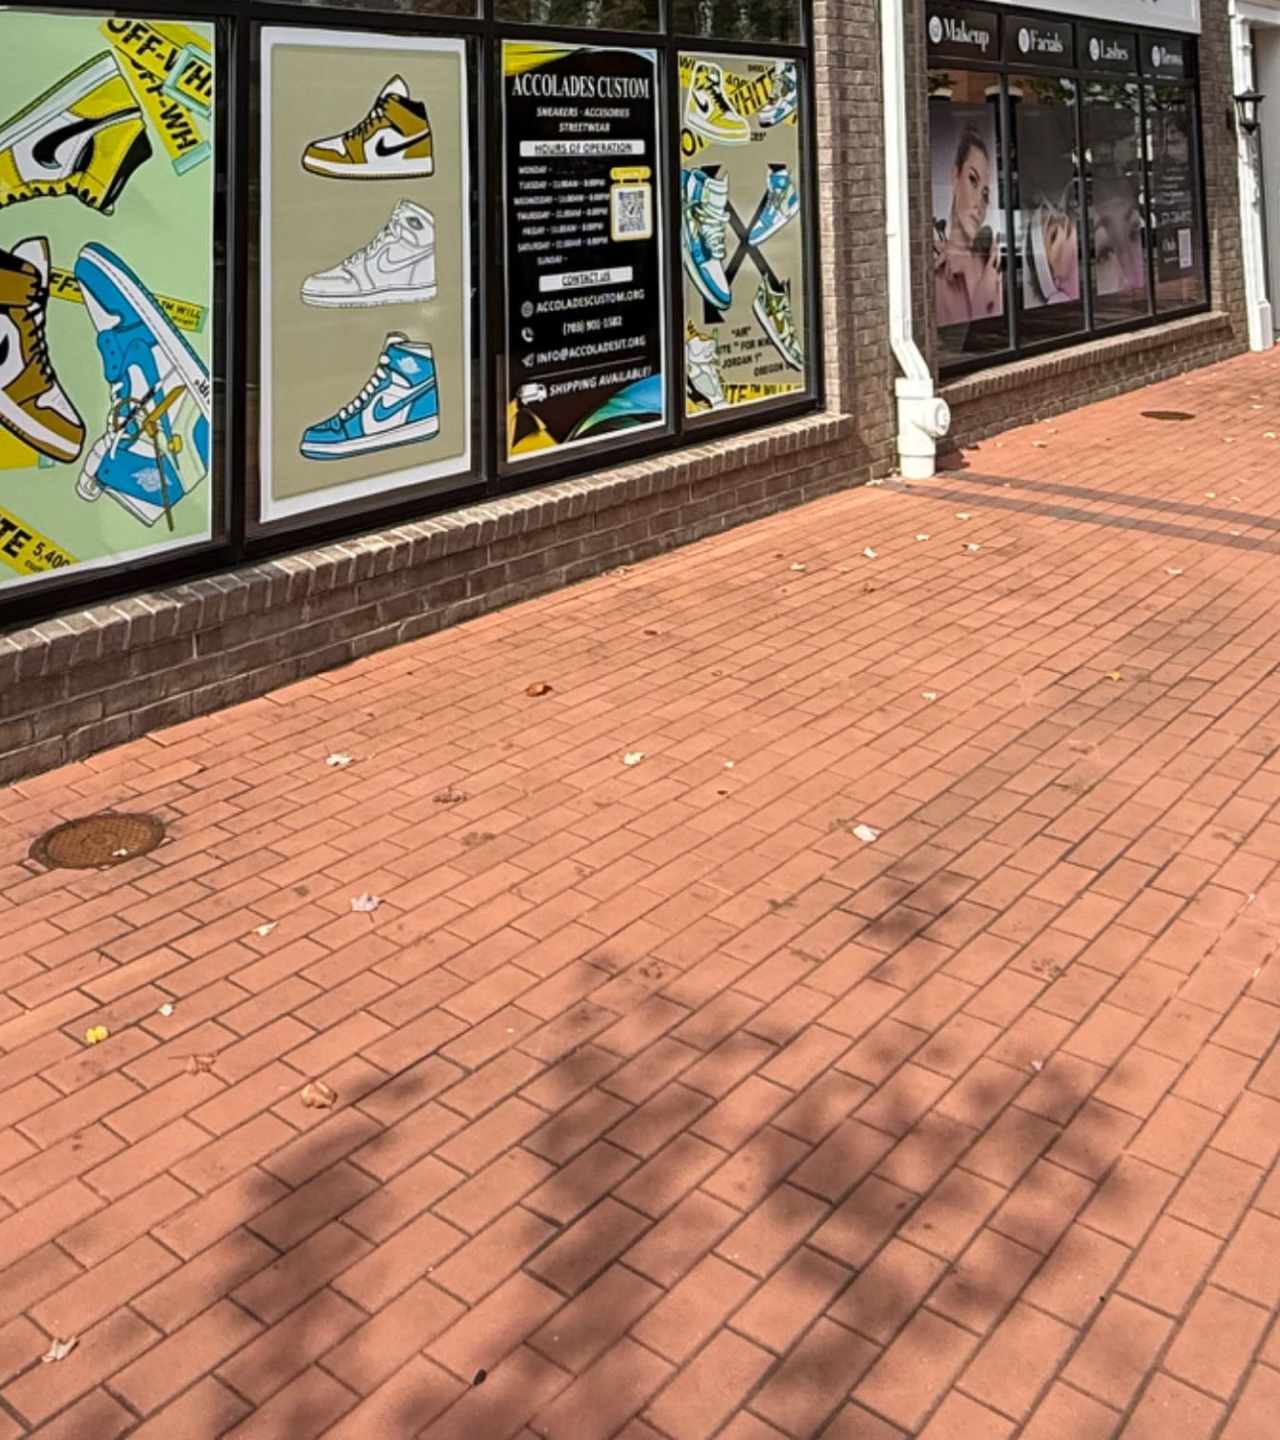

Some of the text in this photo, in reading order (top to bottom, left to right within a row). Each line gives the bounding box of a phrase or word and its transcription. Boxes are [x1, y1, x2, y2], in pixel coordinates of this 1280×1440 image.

[943, 17, 990, 53] Makeup
[1029, 25, 1064, 54] Facials
[1099, 40, 1129, 61] Lashes
[511, 73, 650, 99] ACCOLADES CUSTOM
[558, 122, 611, 133] STREETWEAR
[534, 142, 633, 155] HOURS OF OPERATION
[561, 272, 599, 287] CONTACT
[549, 377, 598, 397] SHIPPING
